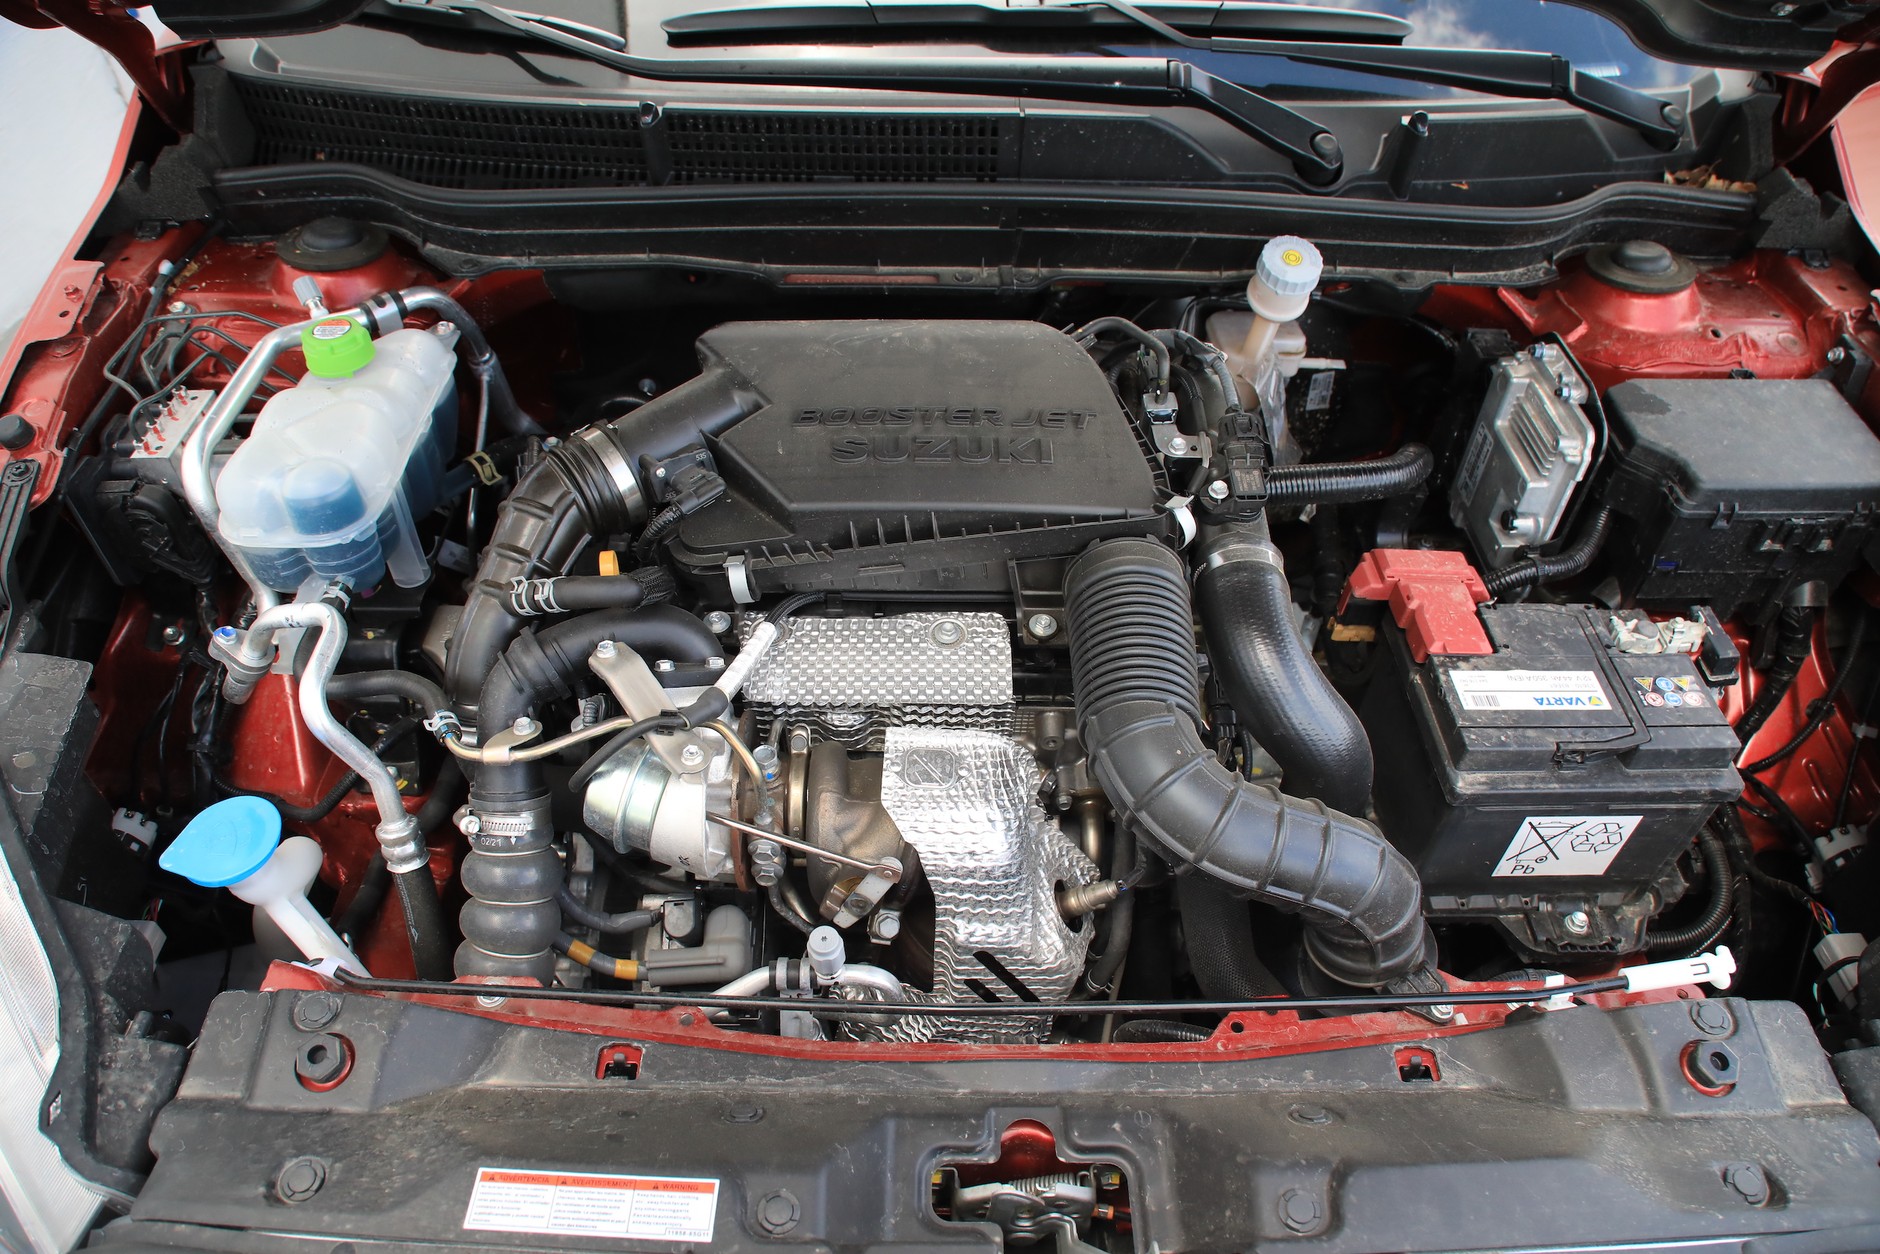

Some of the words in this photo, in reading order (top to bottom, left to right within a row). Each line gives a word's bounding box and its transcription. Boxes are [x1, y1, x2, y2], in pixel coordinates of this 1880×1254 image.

[831, 435, 1054, 464] SUZUKI
[1533, 696, 1586, 706] VARTA
[480, 837, 502, 847] 02/21
[1510, 864, 1535, 875] Pb
[662, 1183, 699, 1191] WARNING
